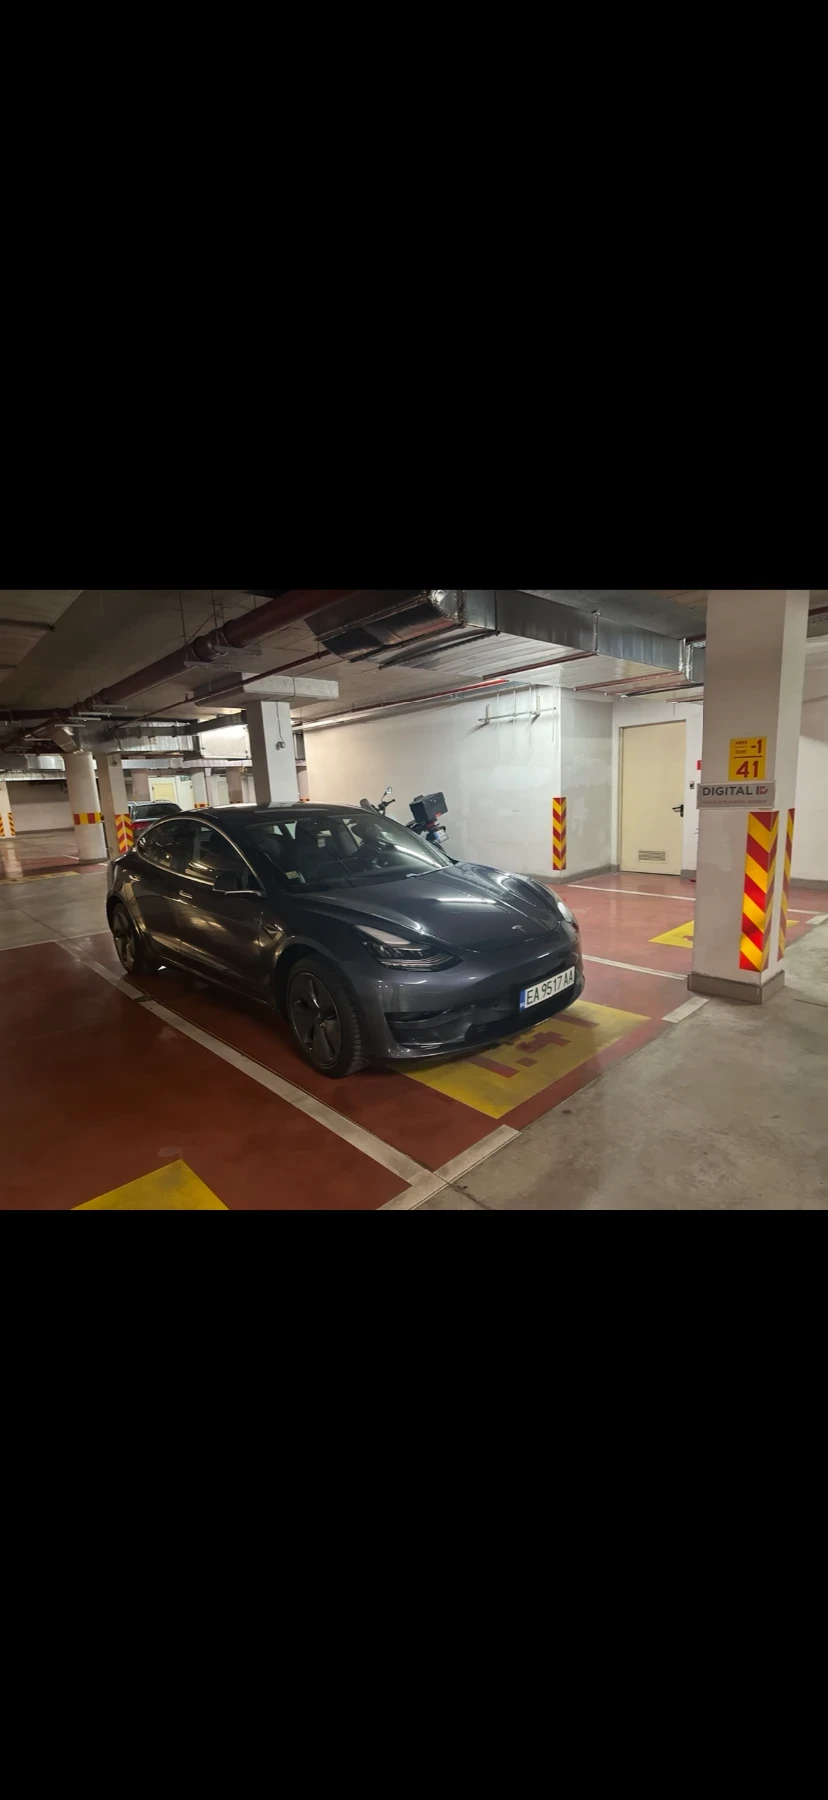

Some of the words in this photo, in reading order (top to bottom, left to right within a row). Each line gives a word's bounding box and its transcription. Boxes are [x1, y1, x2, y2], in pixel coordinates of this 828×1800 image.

[751, 739, 762, 753] -1
[736, 760, 758, 777] 41
[702, 786, 753, 796] DIGITAL
[526, 987, 540, 1005] EA
[541, 975, 562, 998] 9517
[563, 970, 573, 987] AA
